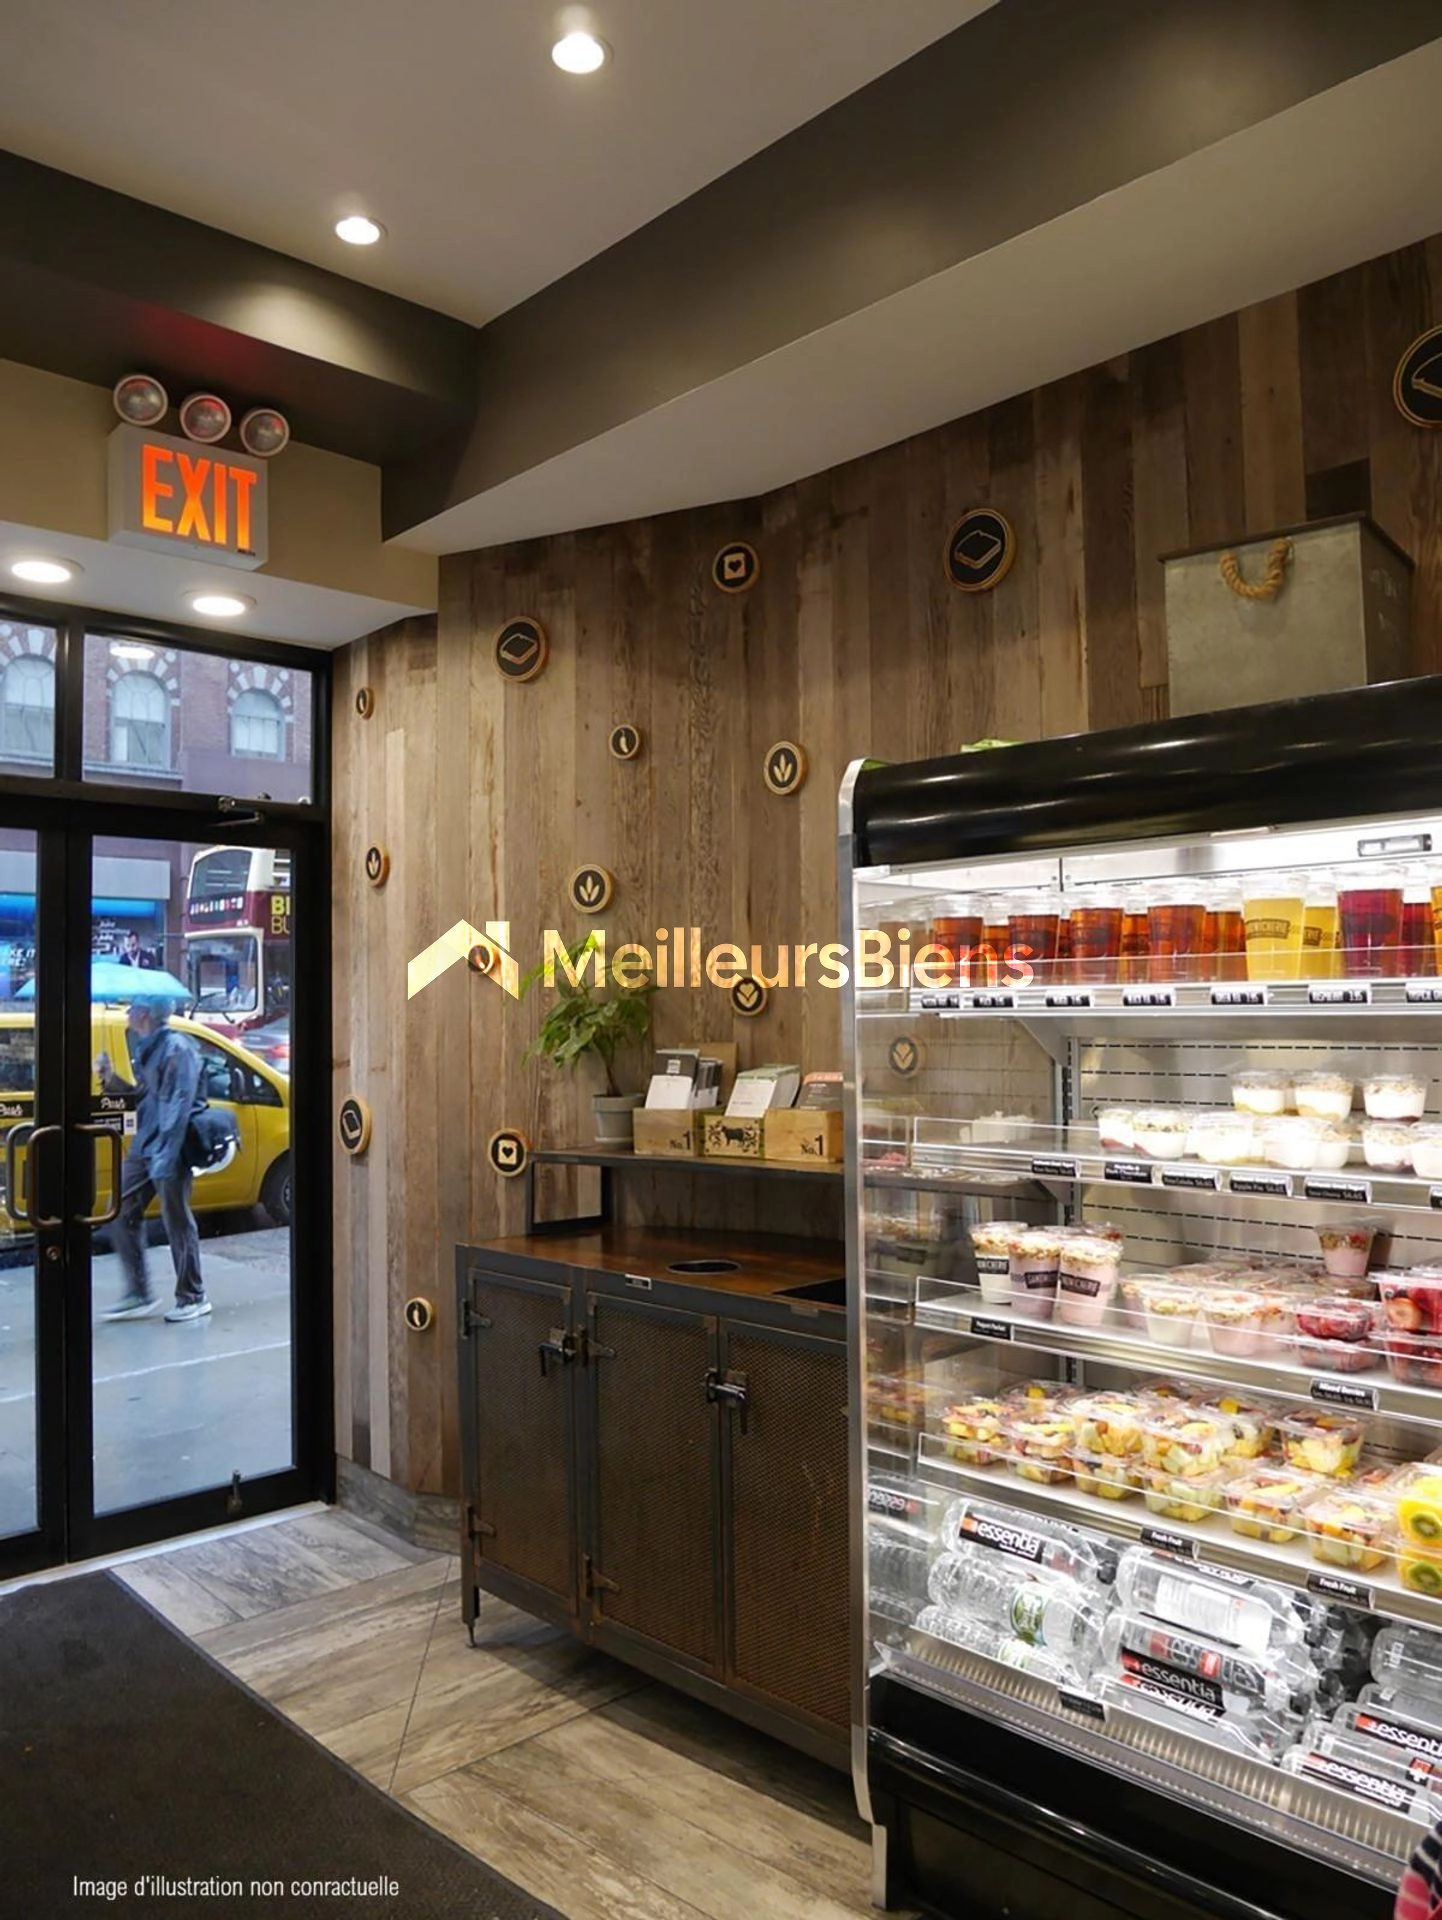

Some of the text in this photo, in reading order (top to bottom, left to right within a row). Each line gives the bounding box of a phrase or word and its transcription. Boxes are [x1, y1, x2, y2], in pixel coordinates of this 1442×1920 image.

[142, 443, 258, 551] EXIT
[977, 1521, 1041, 1556] essentia
[1141, 1662, 1217, 1703] essentia
[1328, 1763, 1406, 1801] essentia
